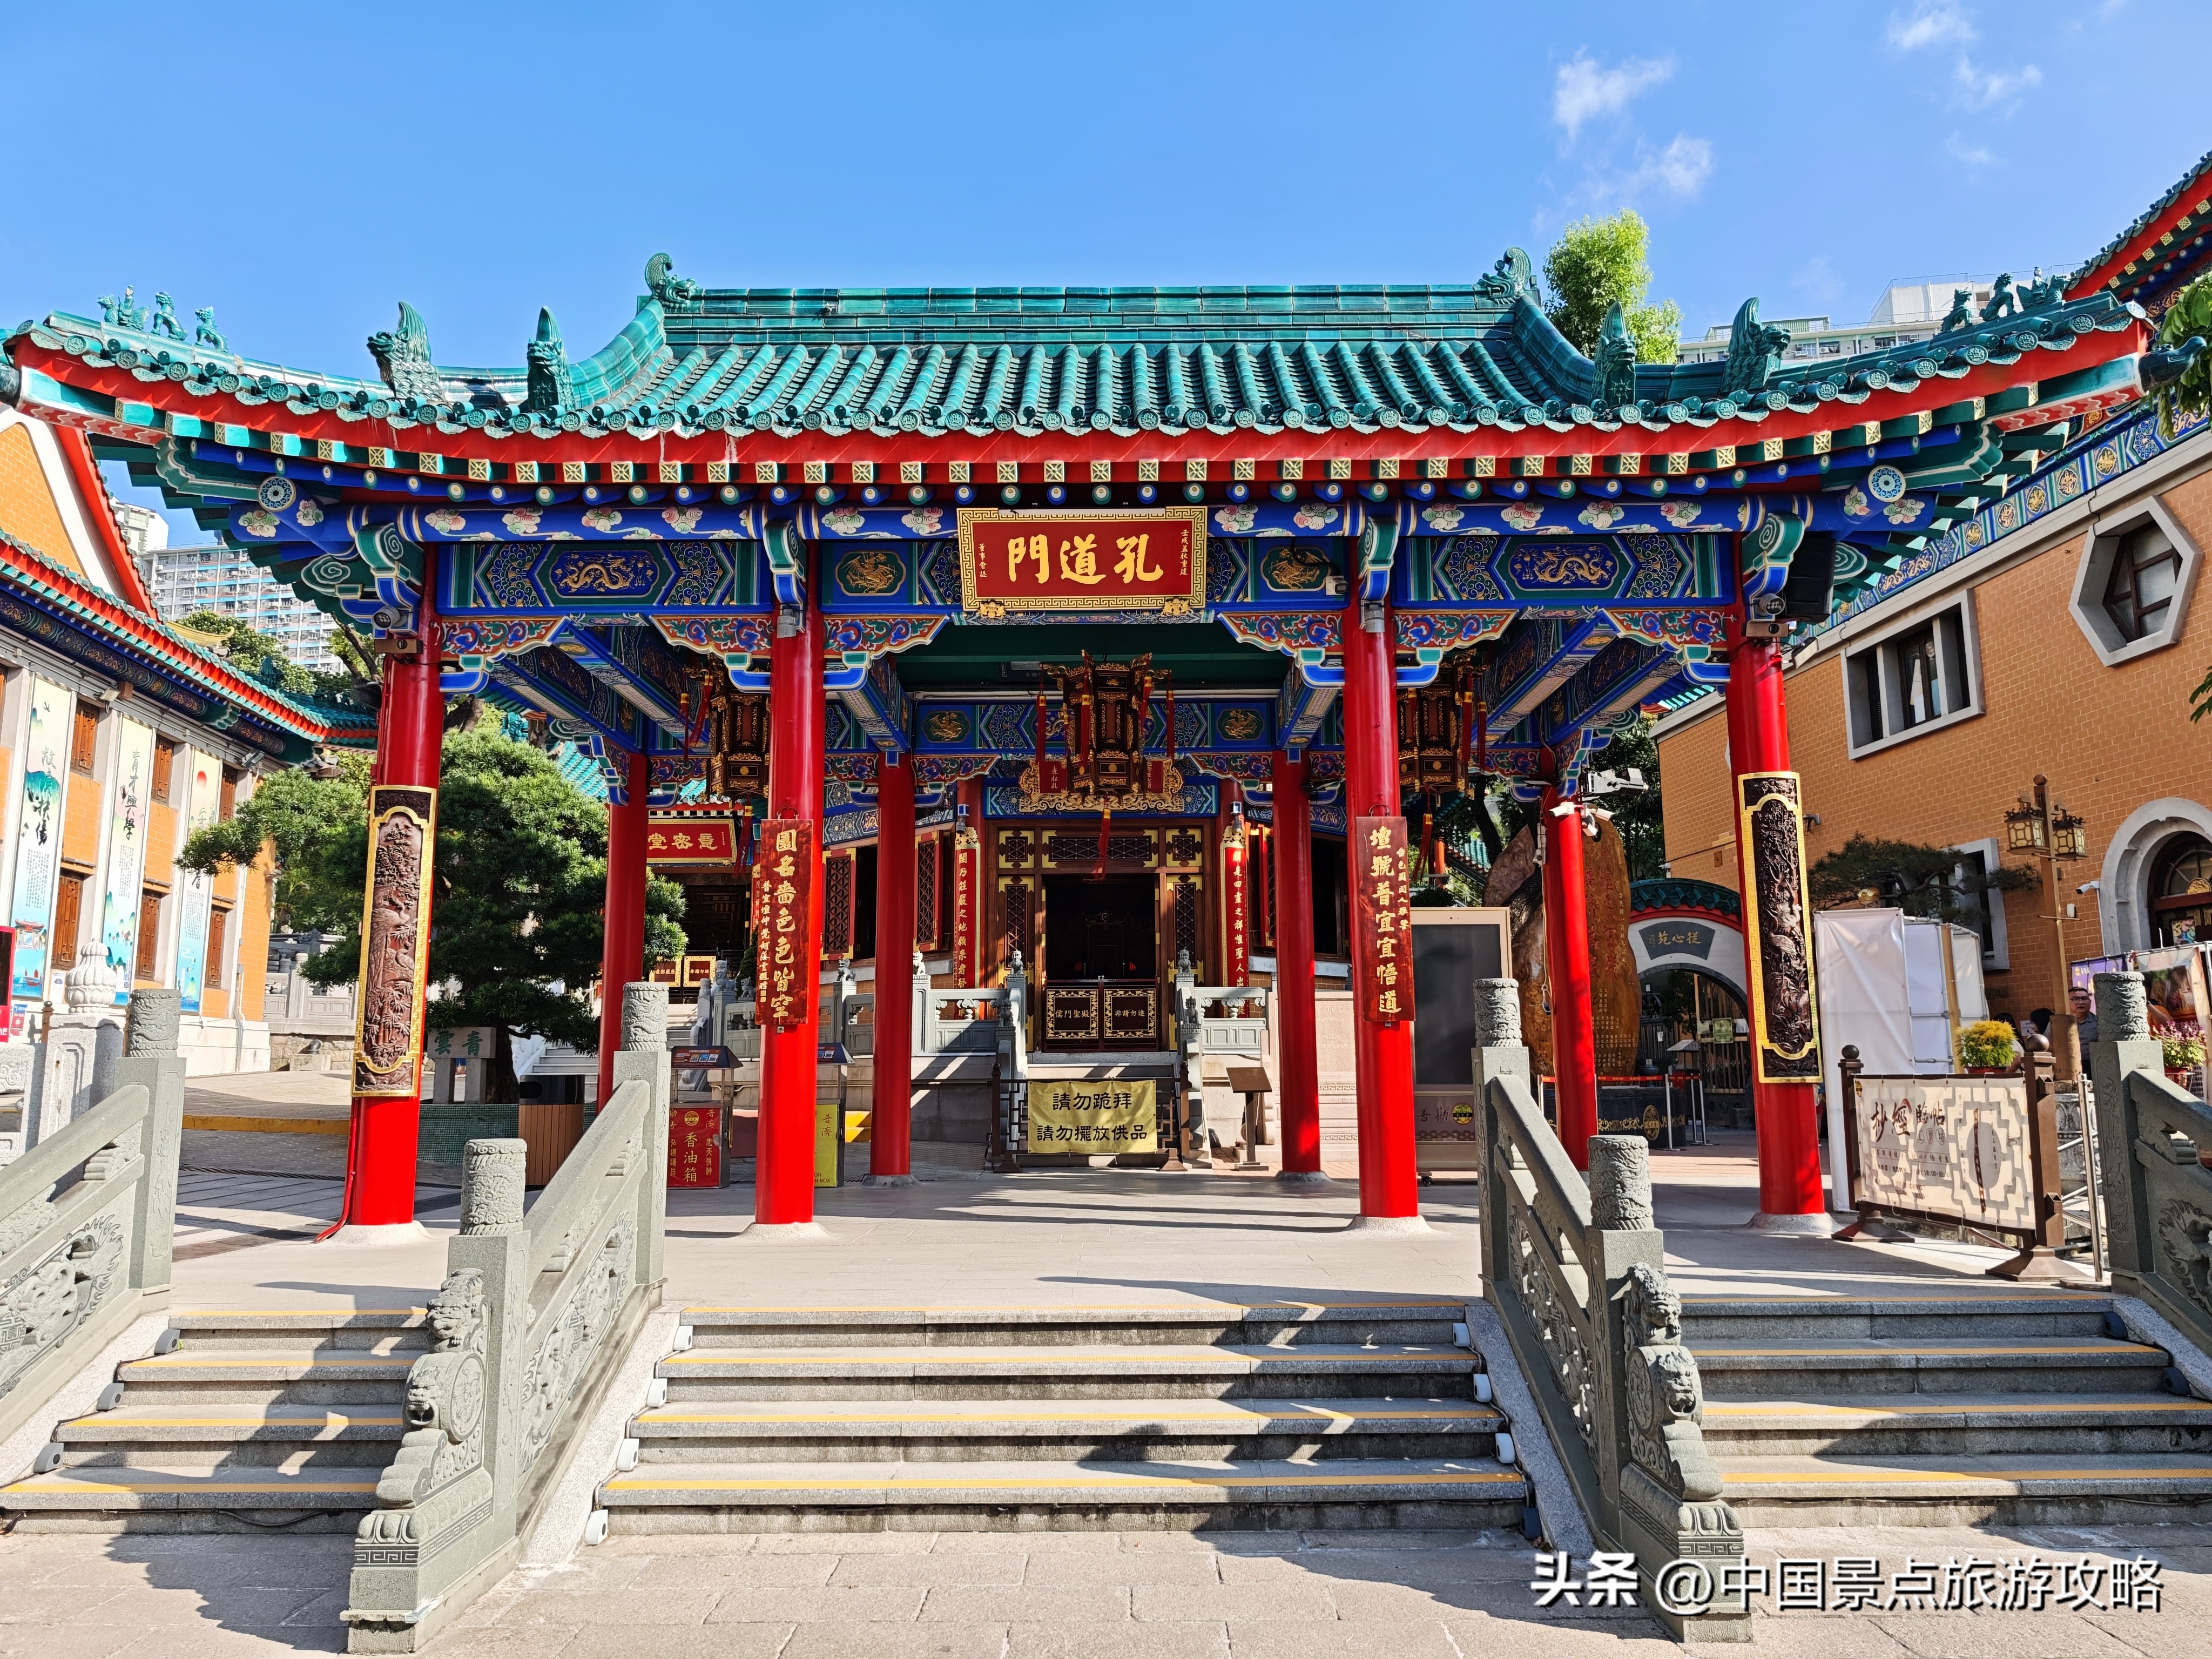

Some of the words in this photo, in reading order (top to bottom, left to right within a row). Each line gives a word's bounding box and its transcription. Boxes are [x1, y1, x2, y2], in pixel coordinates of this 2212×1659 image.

[1008, 534, 1164, 584] 孔道門
[771, 829, 797, 1018] 園名嗇色色皆空
[1369, 825, 1402, 1013] 壇號普宜宜悟道
[1055, 1009, 1090, 1019] 儒門聖殿
[1114, 1009, 1145, 1017] 非請勿進
[434, 1029, 484, 1057] 青雲
[1051, 1091, 1133, 1111] 請勿跪拜
[1036, 1124, 1148, 1142] 請勿擺放供品
[1870, 1101, 1946, 1143] 抄經臨帖
[683, 1131, 698, 1183] 香油箱
